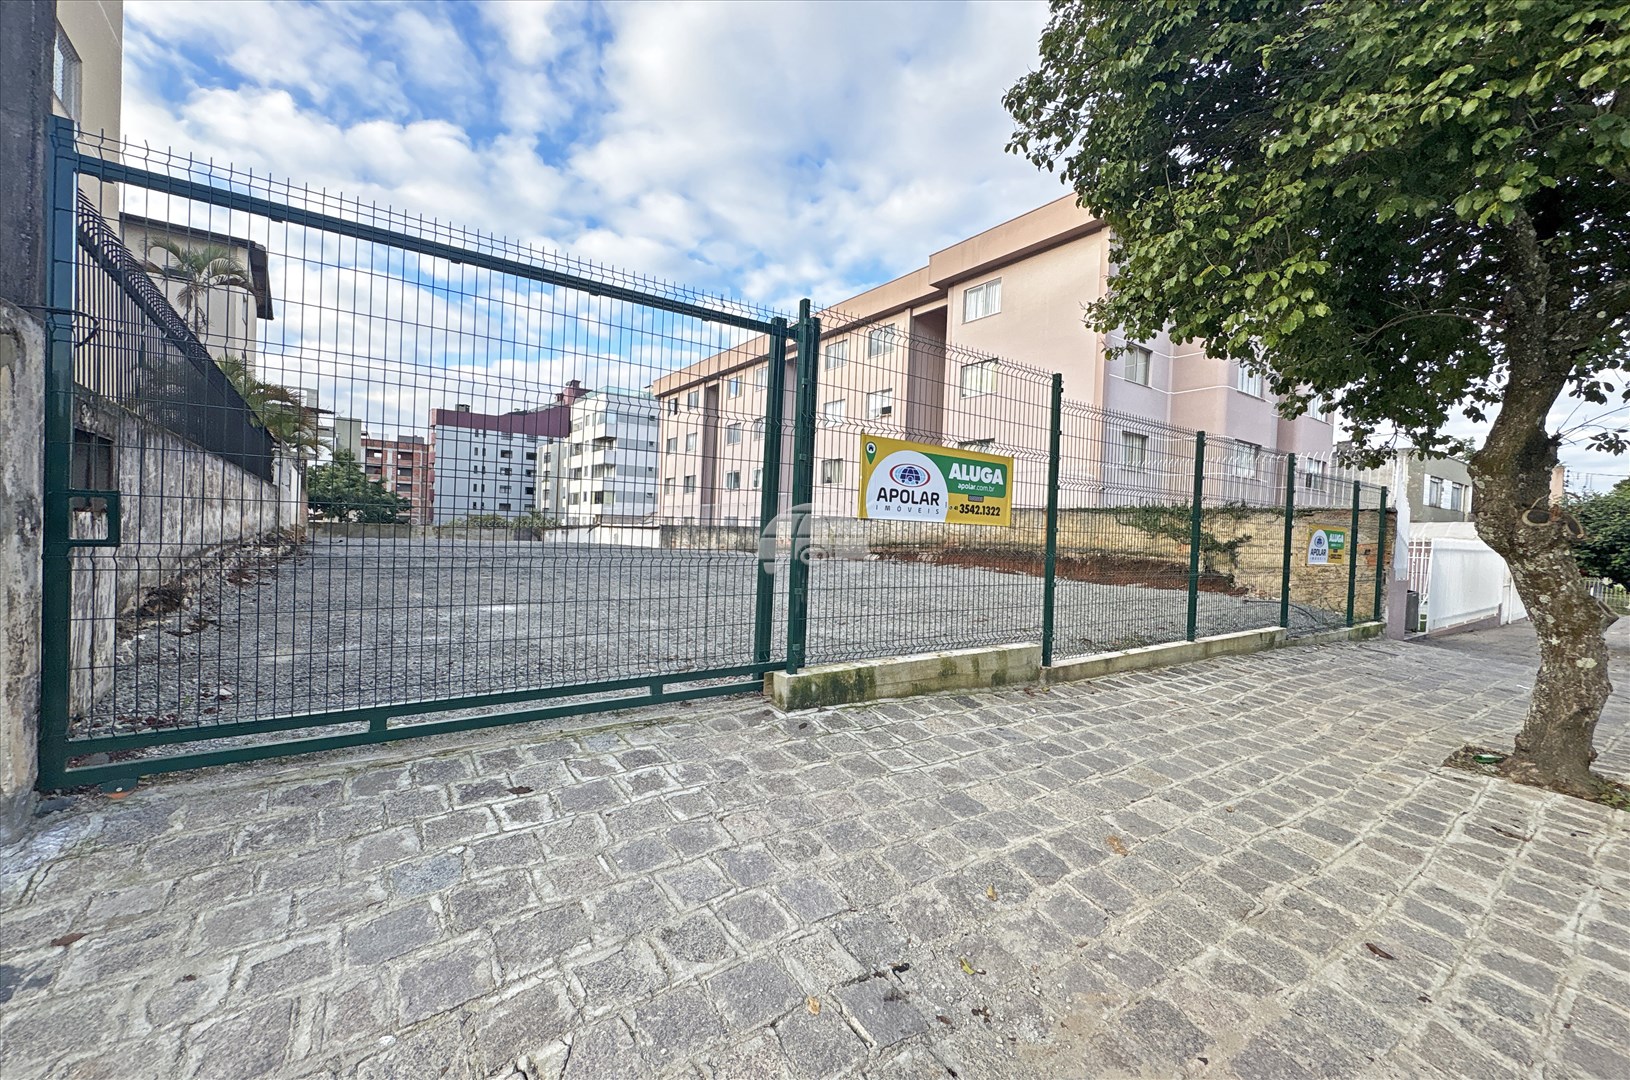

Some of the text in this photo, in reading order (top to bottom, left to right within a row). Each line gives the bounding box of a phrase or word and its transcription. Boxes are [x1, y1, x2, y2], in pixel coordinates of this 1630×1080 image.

[948, 463, 1003, 485] ALUGA
[958, 483, 994, 492] apolar.com.br
[877, 487, 939, 506] APOLAR
[959, 504, 1000, 516] 3542.1322
